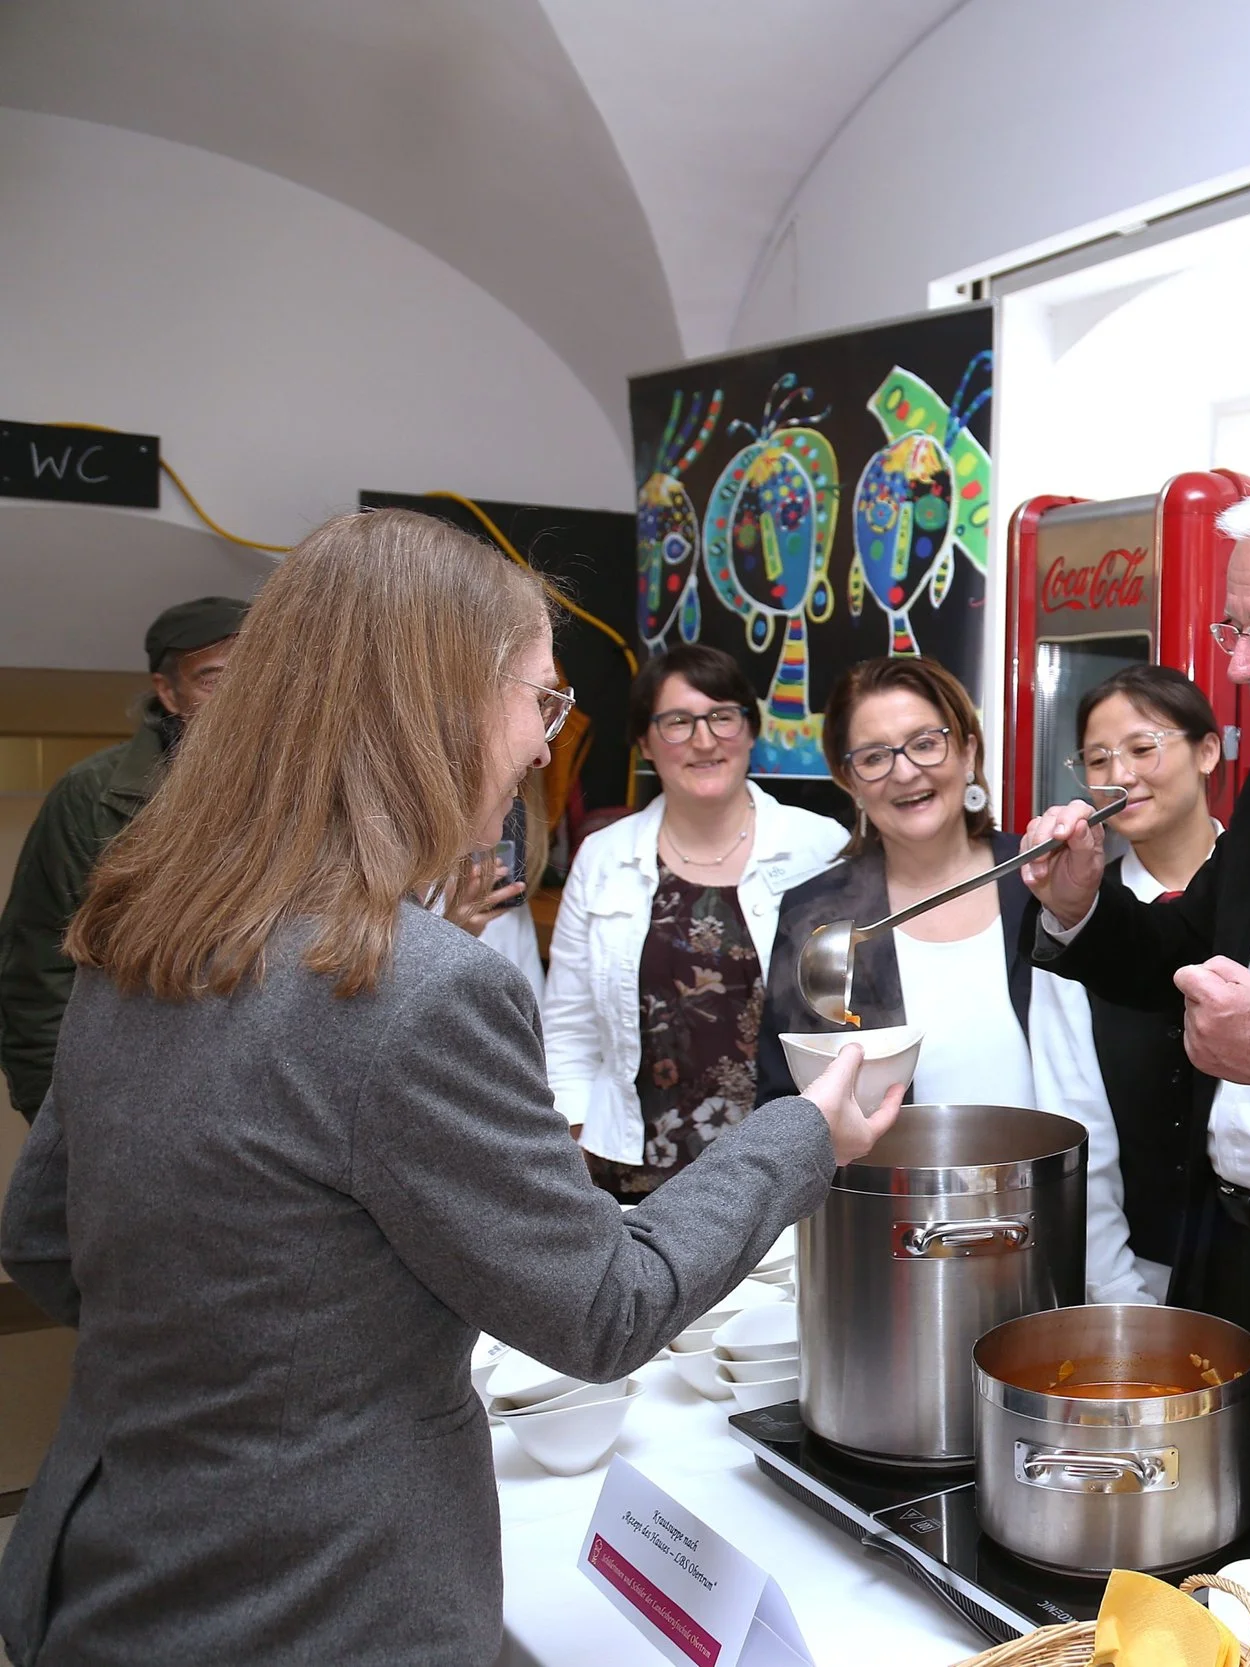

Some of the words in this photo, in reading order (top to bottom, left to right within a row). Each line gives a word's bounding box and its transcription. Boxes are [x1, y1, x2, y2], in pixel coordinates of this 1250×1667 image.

[30, 441, 109, 483] WC
[1041, 546, 1148, 614] Coca-Cola
[641, 1524, 652, 1539] des
[650, 1532, 670, 1554] Hauses
[674, 1553, 690, 1570] LBS
[652, 1510, 684, 1541] Krautsuppe
[683, 1536, 699, 1552] nach
